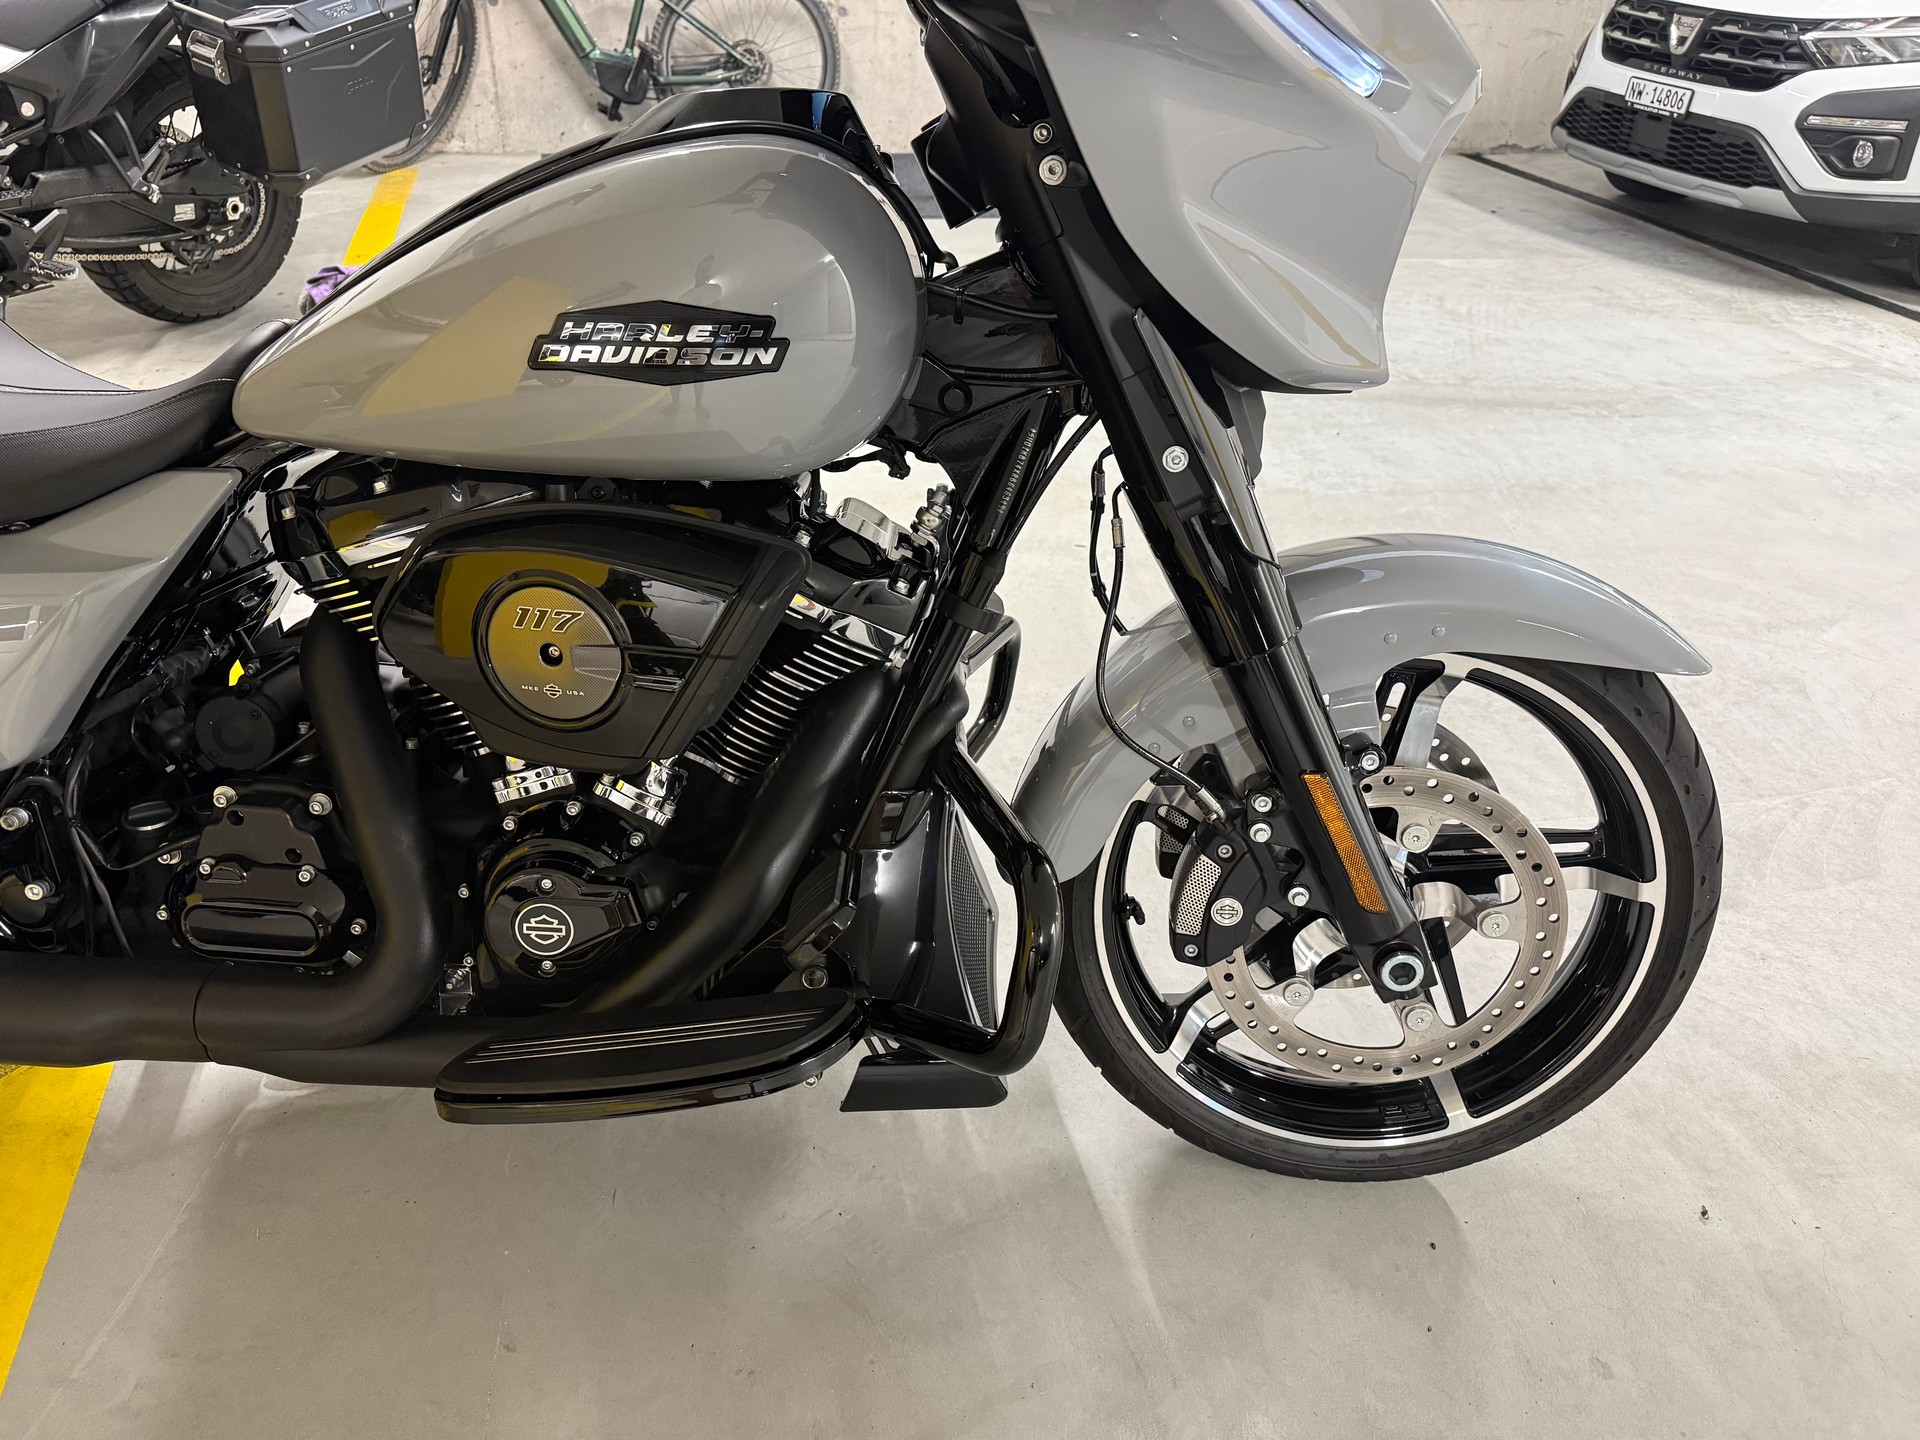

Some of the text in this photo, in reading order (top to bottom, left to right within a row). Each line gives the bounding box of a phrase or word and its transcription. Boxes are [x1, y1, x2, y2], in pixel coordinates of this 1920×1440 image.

[1643, 63, 1703, 80] STEPWAY
[560, 321, 764, 343] HARLEY-
[538, 344, 779, 366] DAVIDSON
[512, 605, 585, 633] 117
[521, 684, 540, 692] MKE
